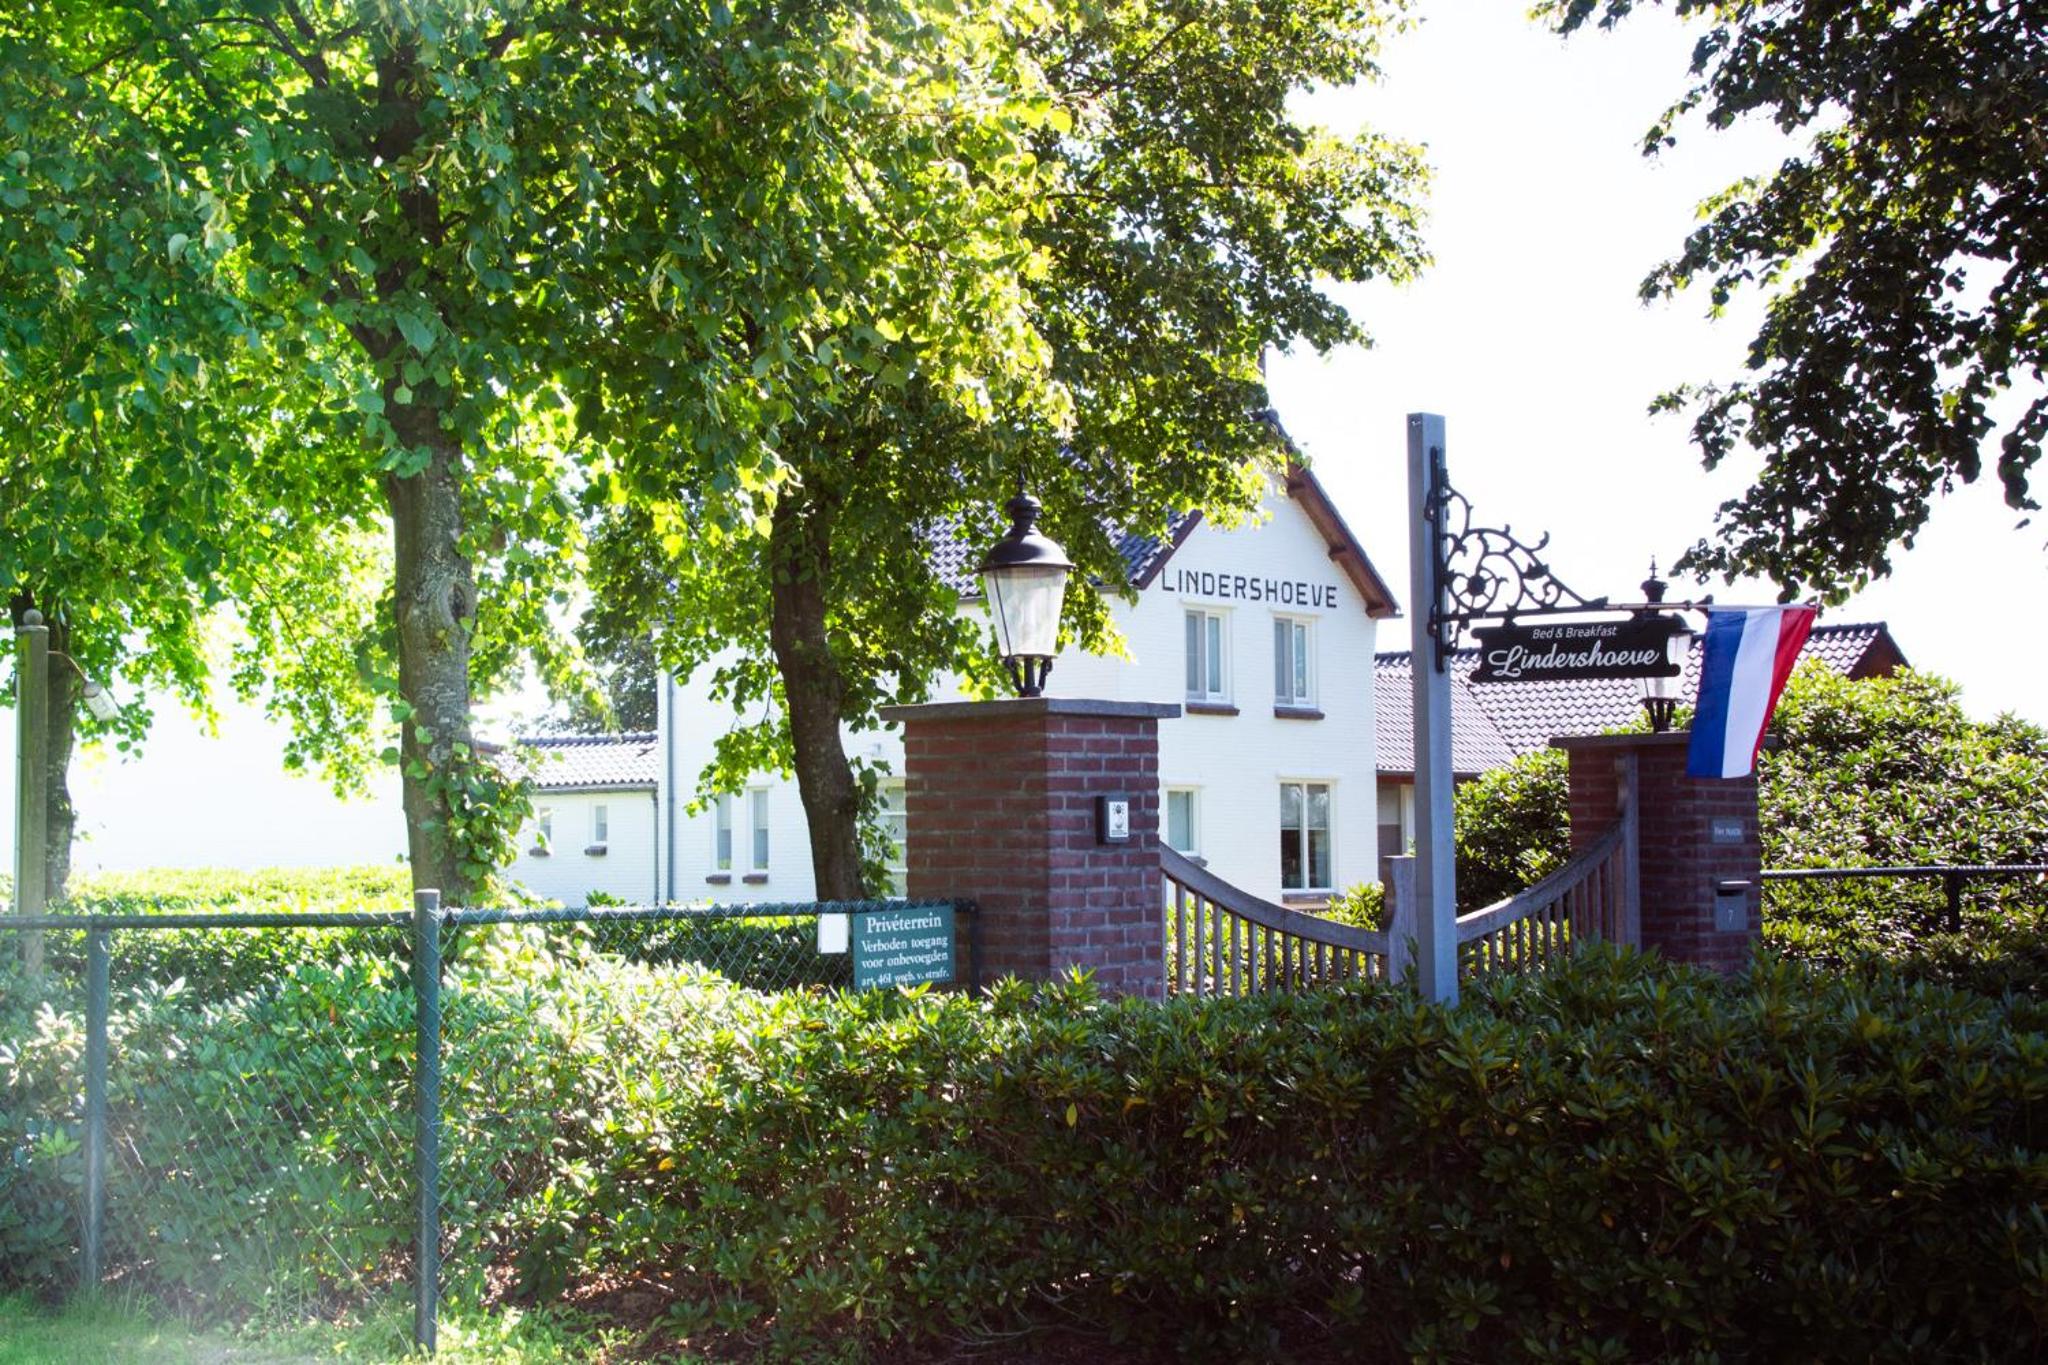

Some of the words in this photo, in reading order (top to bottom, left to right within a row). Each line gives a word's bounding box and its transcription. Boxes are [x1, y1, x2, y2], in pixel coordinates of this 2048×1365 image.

[1161, 567, 1337, 608] LINDERSHOEVE
[1532, 627, 1552, 639] Bed
[1555, 628, 1563, 638] &
[1565, 625, 1617, 638] Breakfast
[1488, 640, 1660, 677] Lindershoeve
[866, 912, 942, 933] Privéterrein
[861, 938, 908, 952] Verboden
[911, 936, 948, 949] toegang
[861, 959, 884, 968] voor
[887, 950, 948, 966] onbevoegden
[878, 973, 891, 985] 461
